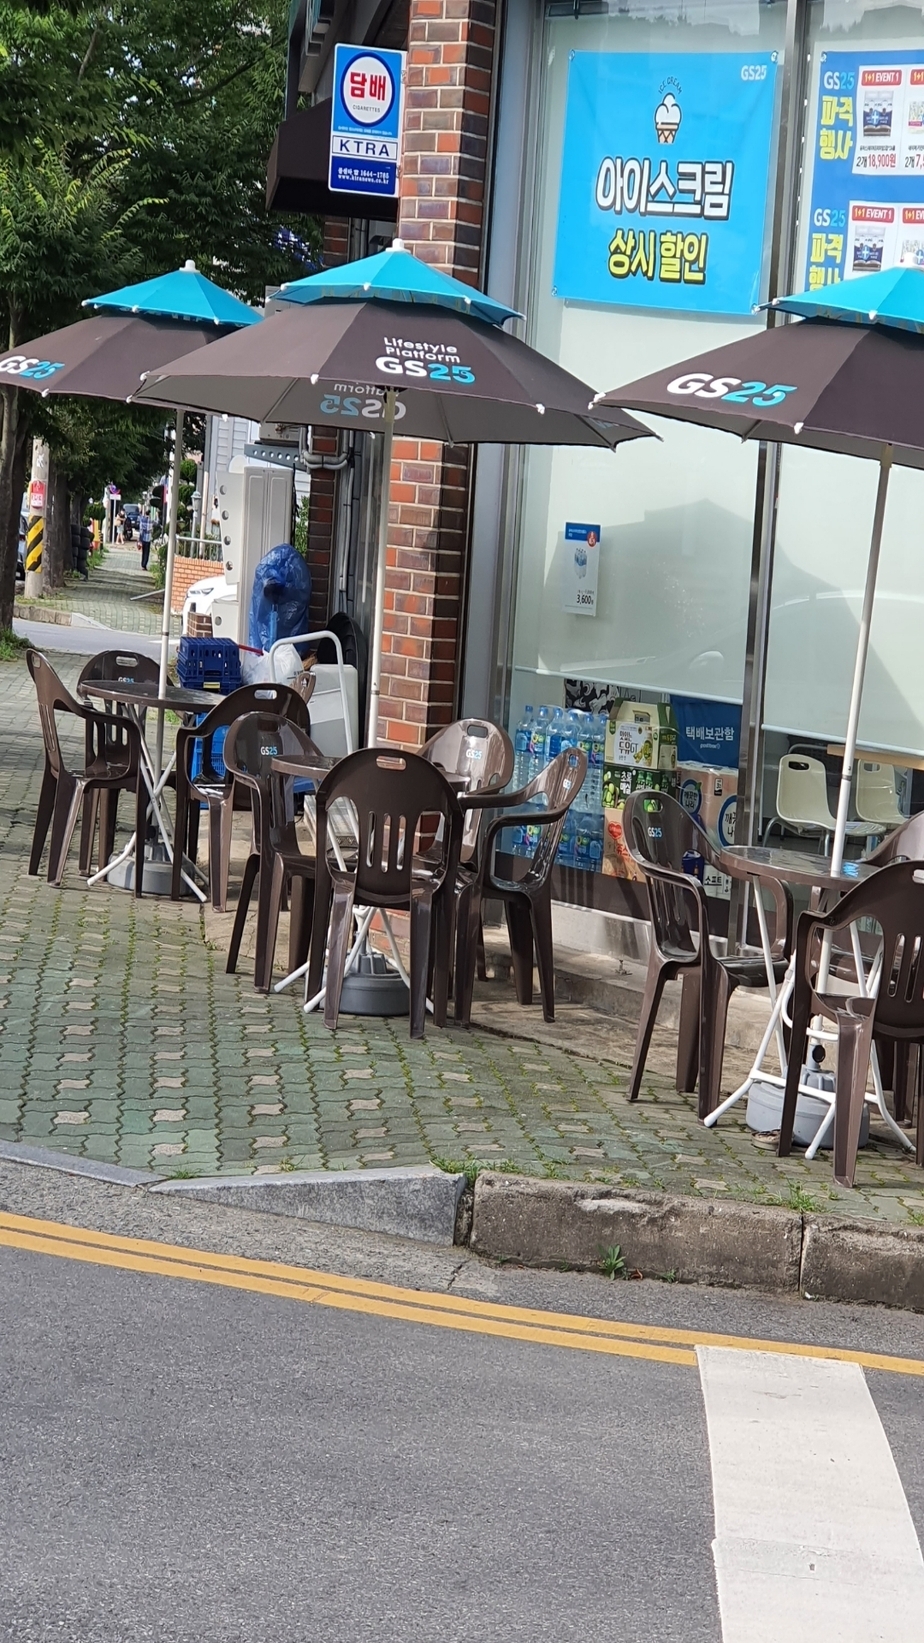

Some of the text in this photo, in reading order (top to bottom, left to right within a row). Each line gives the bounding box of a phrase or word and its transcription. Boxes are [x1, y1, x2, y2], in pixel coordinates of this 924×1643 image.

[740, 65, 767, 81] GS25
[823, 71, 855, 90] GS25
[875, 72, 895, 82] EVENT
[350, 71, 387, 101] 담배
[658, 76, 682, 94] ICE CREAM
[352, 104, 381, 113] CIGARETTES
[820, 95, 854, 127] 파격
[339, 139, 390, 157] KTRA
[819, 127, 853, 160] 행사
[856, 153, 896, 169] 2개 18,900원
[595, 156, 735, 220] 아이스크림
[813, 208, 846, 227] GS25
[866, 208, 888, 219] EVENT
[608, 228, 709, 284] 상시 할인
[810, 232, 844, 264] 파격
[383, 336, 458, 354] Lifestyle
[385, 346, 461, 363] Platform
[0, 355, 66, 379] GS25
[375, 356, 476, 384] GS25
[666, 373, 798, 407] GS25
[685, 726, 735, 741] 택배보관함
[260, 746, 278, 755] GS25
[465, 749, 482, 760] GS25
[647, 826, 662, 838] GS25
[704, 875, 722, 886] 소프트
